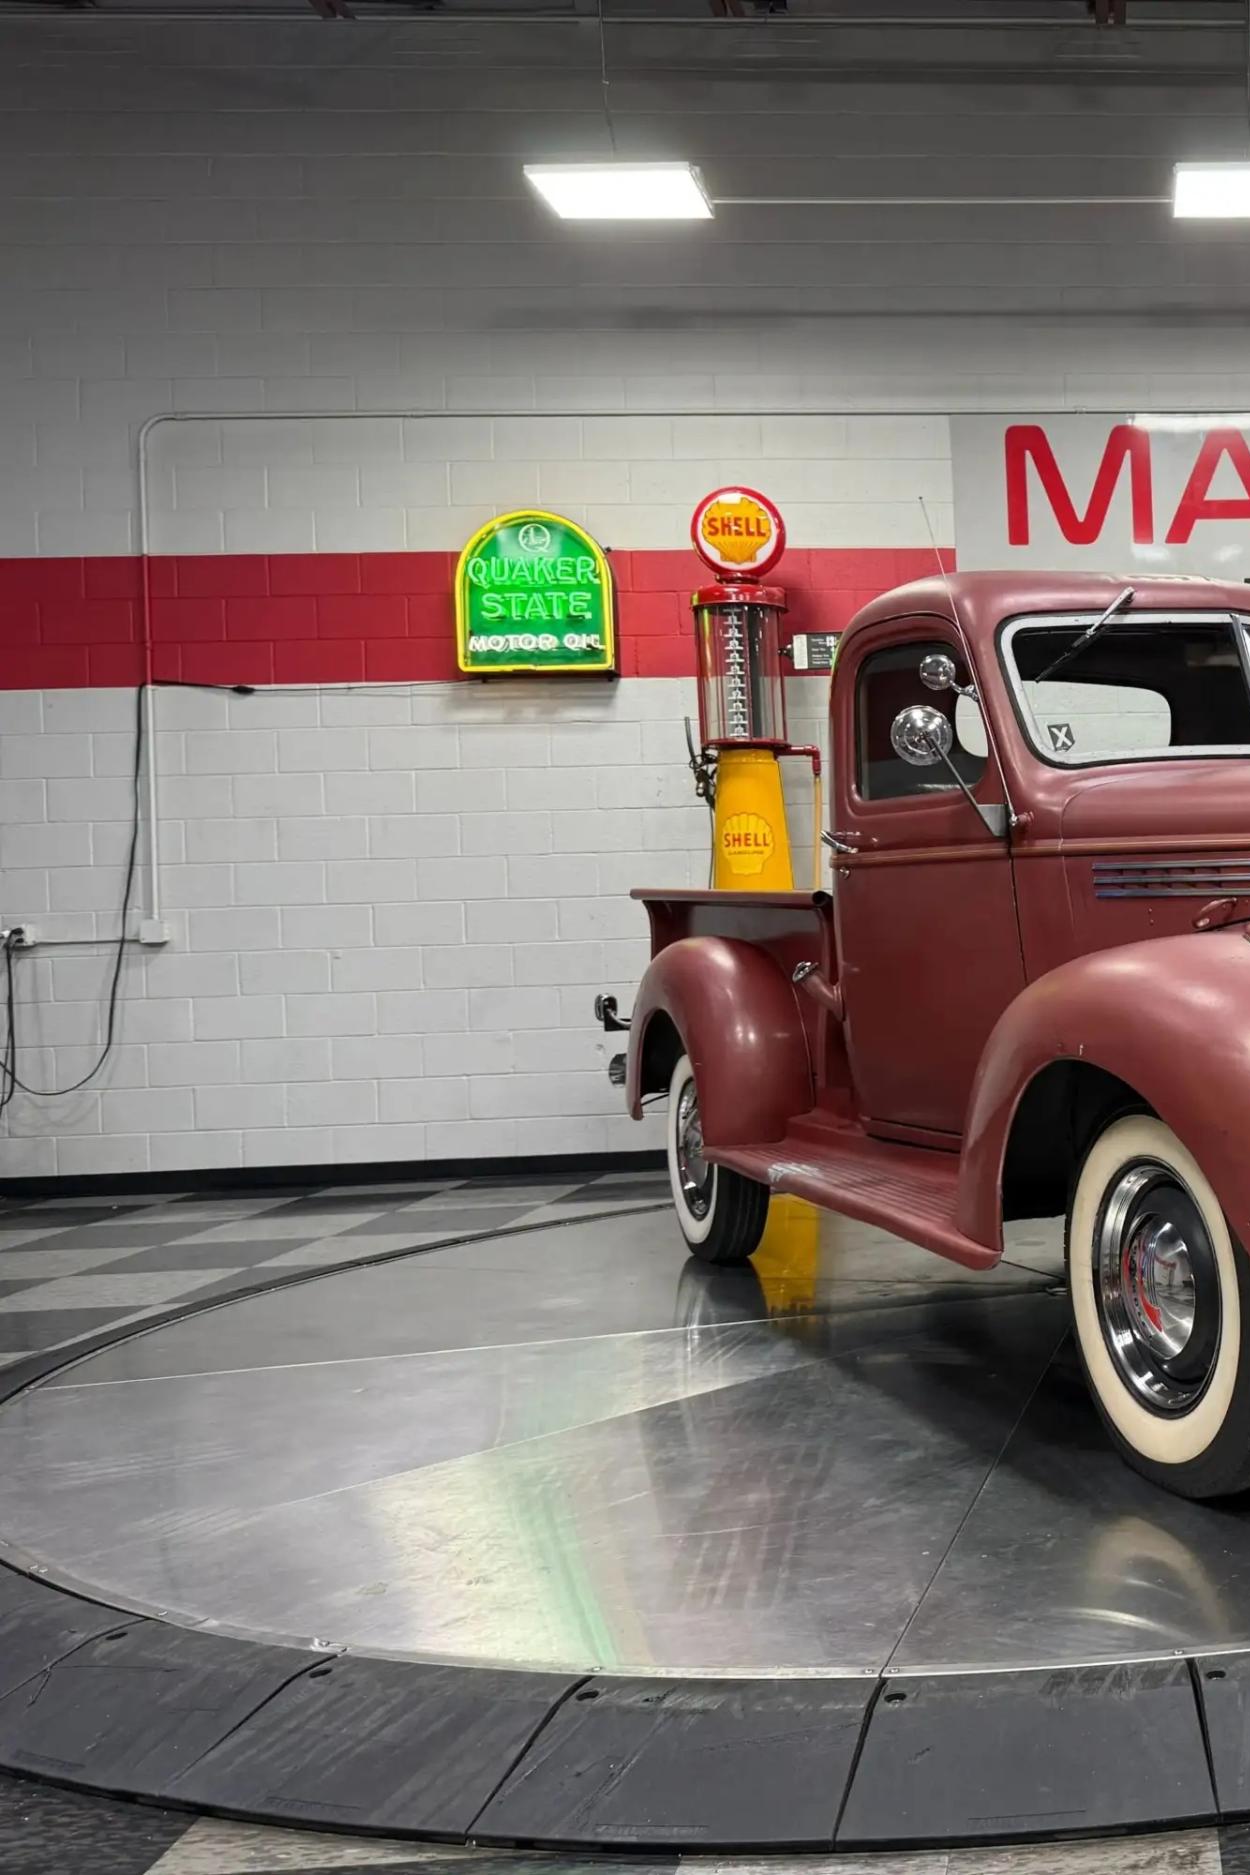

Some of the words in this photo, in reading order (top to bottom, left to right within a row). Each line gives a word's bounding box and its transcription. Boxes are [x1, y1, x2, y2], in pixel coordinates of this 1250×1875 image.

[707, 516, 767, 538] SHELL
[467, 556, 601, 589] QUAKER
[481, 591, 593, 621] STATE
[469, 633, 559, 653] MOTOR
[563, 633, 606, 650] OIL
[723, 832, 770, 848] SHELL
